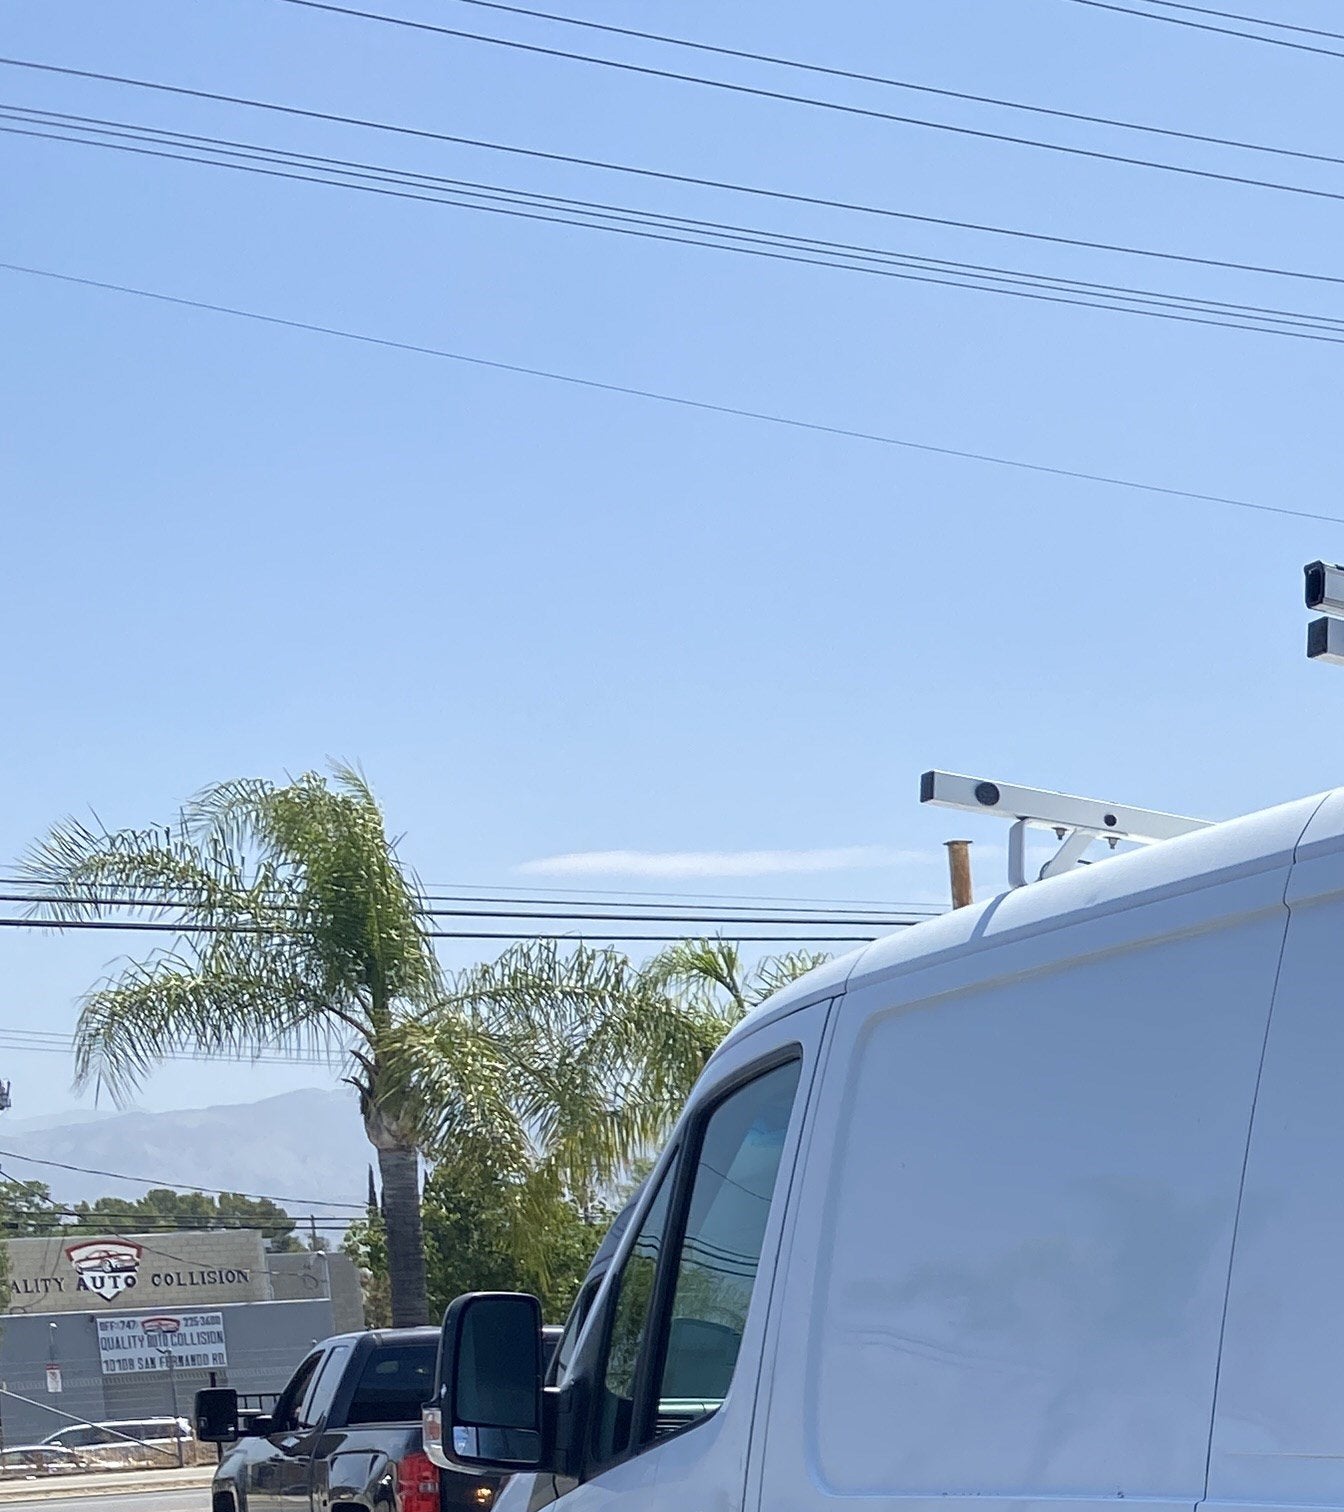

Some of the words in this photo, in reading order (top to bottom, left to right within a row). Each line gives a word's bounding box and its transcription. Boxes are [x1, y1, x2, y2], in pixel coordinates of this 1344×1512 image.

[11, 1278, 65, 1294] ALITY
[76, 1275, 137, 1291] AUTO
[151, 1269, 250, 1287] COLLISION
[101, 1335, 145, 1352] QUALITY
[170, 1330, 224, 1346] COLLISION
[103, 1358, 135, 1372] 10108
[138, 1356, 156, 1370] SAN
[159, 1353, 209, 1369] FERNANDO
